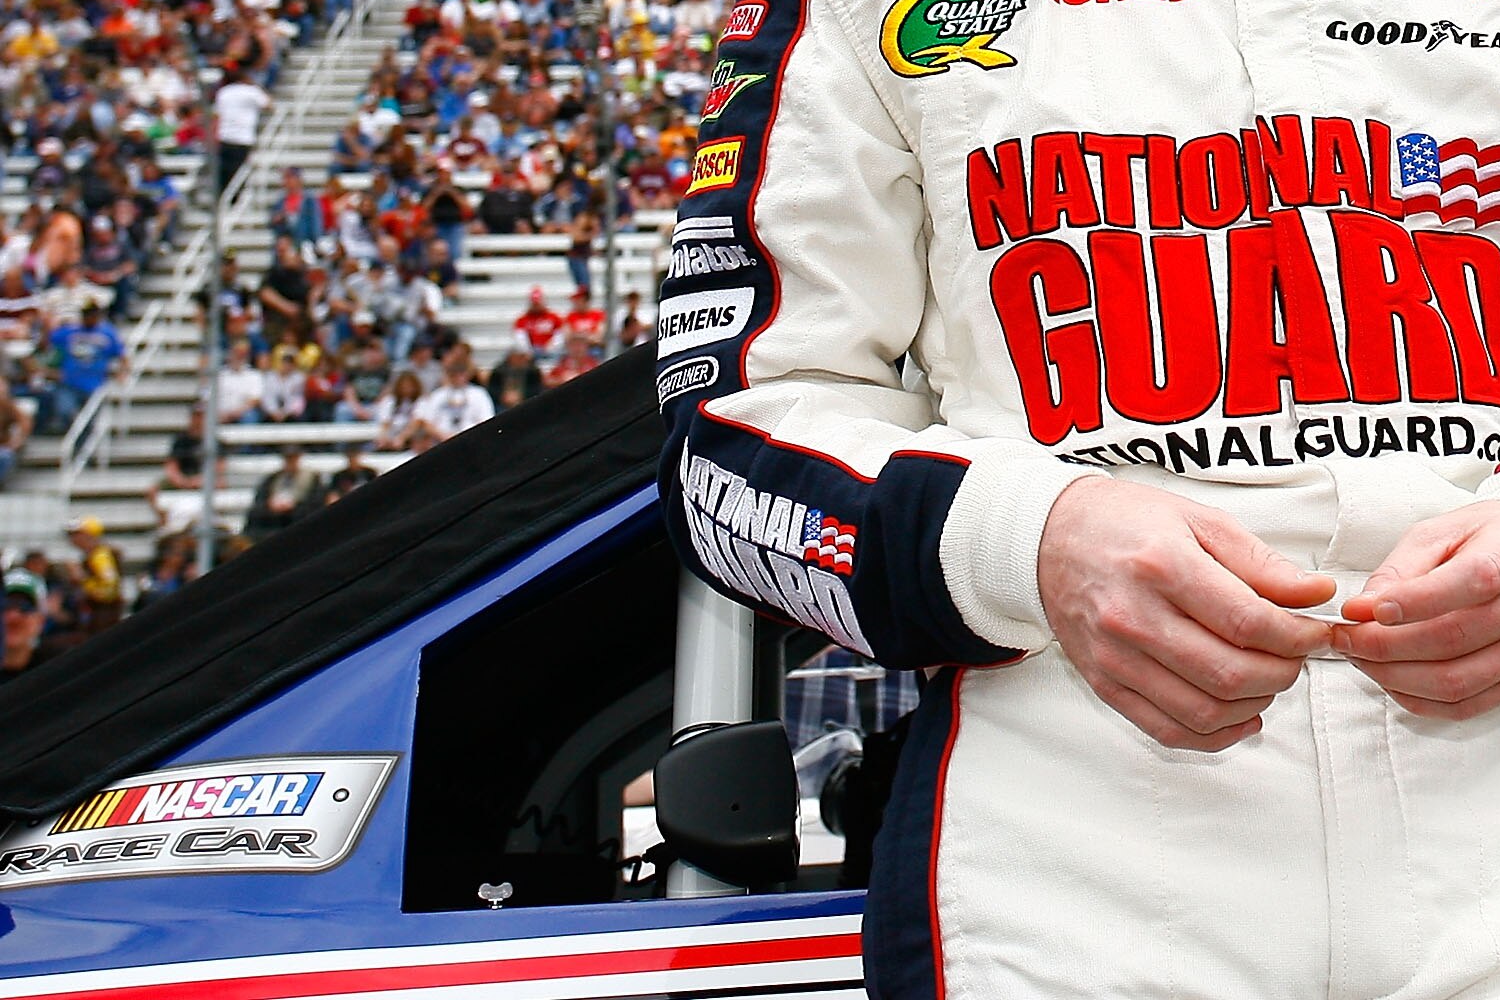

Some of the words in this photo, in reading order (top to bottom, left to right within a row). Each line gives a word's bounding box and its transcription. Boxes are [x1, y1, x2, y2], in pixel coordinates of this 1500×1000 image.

[938, 10, 1013, 37] STATE
[693, 149, 737, 182] OSCH
[966, 114, 1403, 251] NATIONAL
[658, 305, 737, 341] SIEMENS
[127, 773, 310, 825] NASCAR
[0, 836, 165, 873] RACE
[174, 828, 316, 857] CAR
